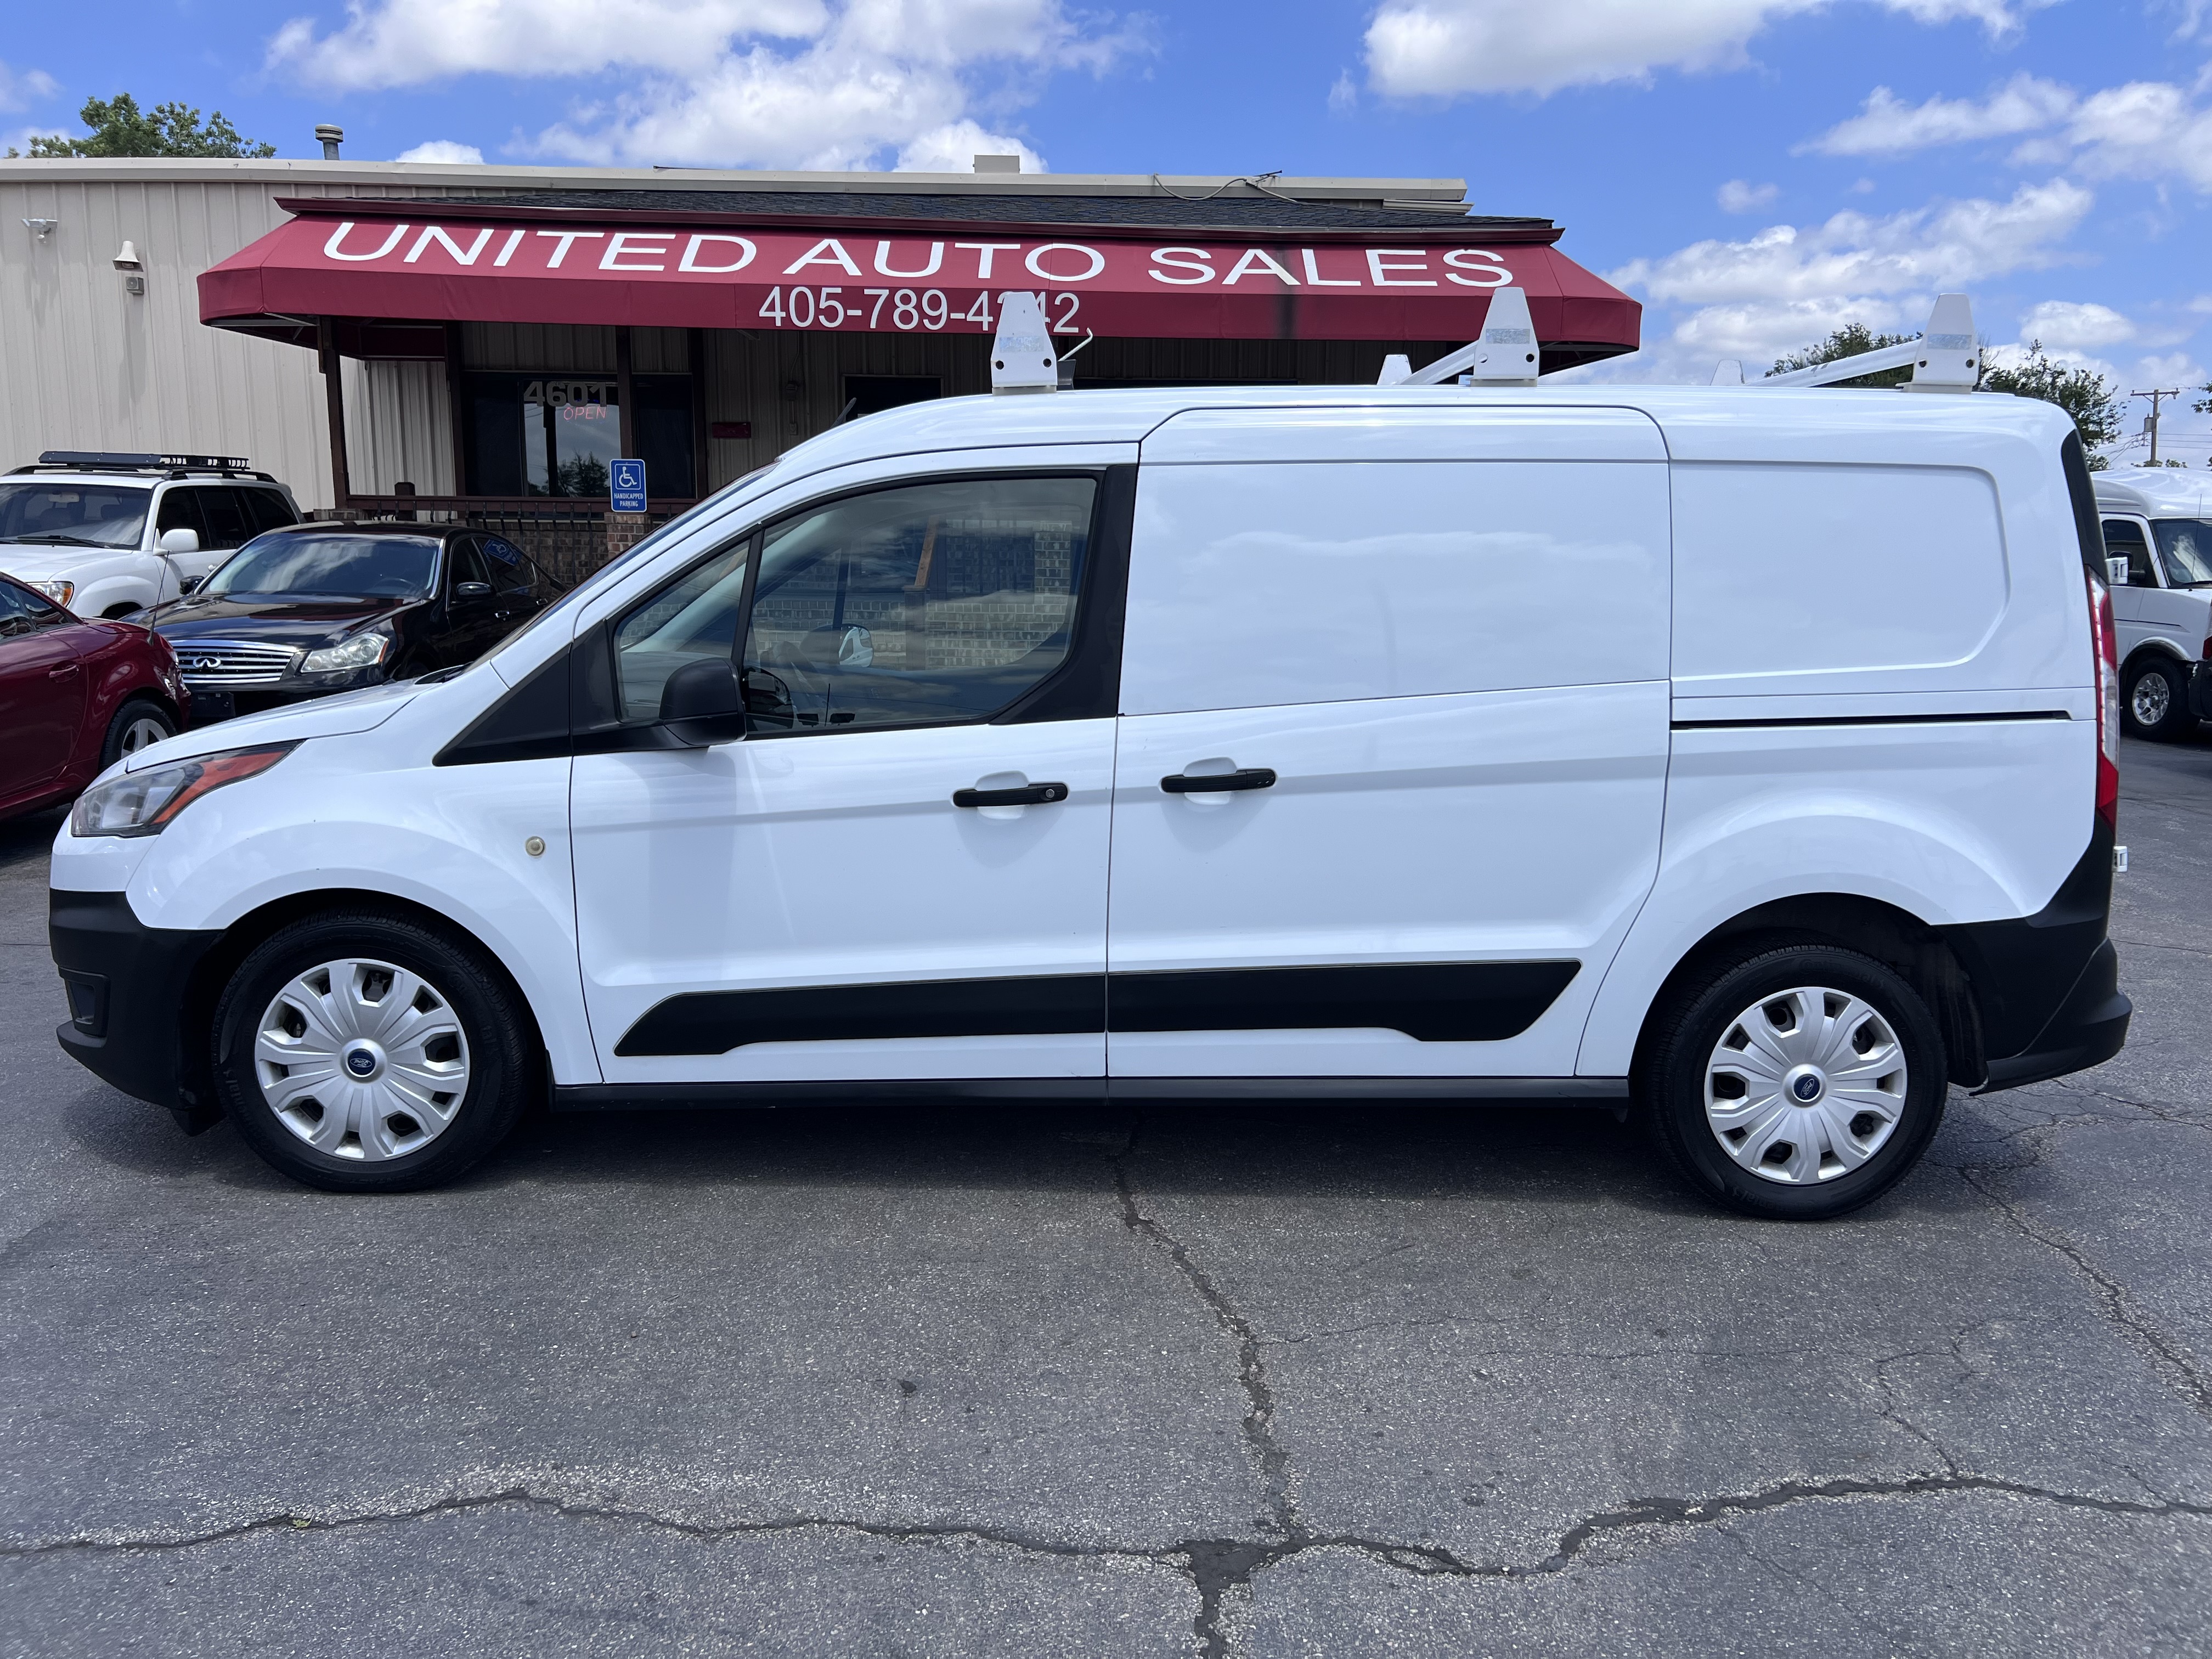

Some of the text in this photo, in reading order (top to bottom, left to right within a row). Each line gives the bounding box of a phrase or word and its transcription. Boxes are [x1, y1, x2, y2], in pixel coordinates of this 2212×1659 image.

[323, 222, 1513, 287] UNITED AUTO SALES
[759, 286, 1080, 333] 405-789-442
[523, 381, 607, 407] 4601
[563, 407, 607, 421] OPEN
[1802, 1081, 1813, 1096] Ford
